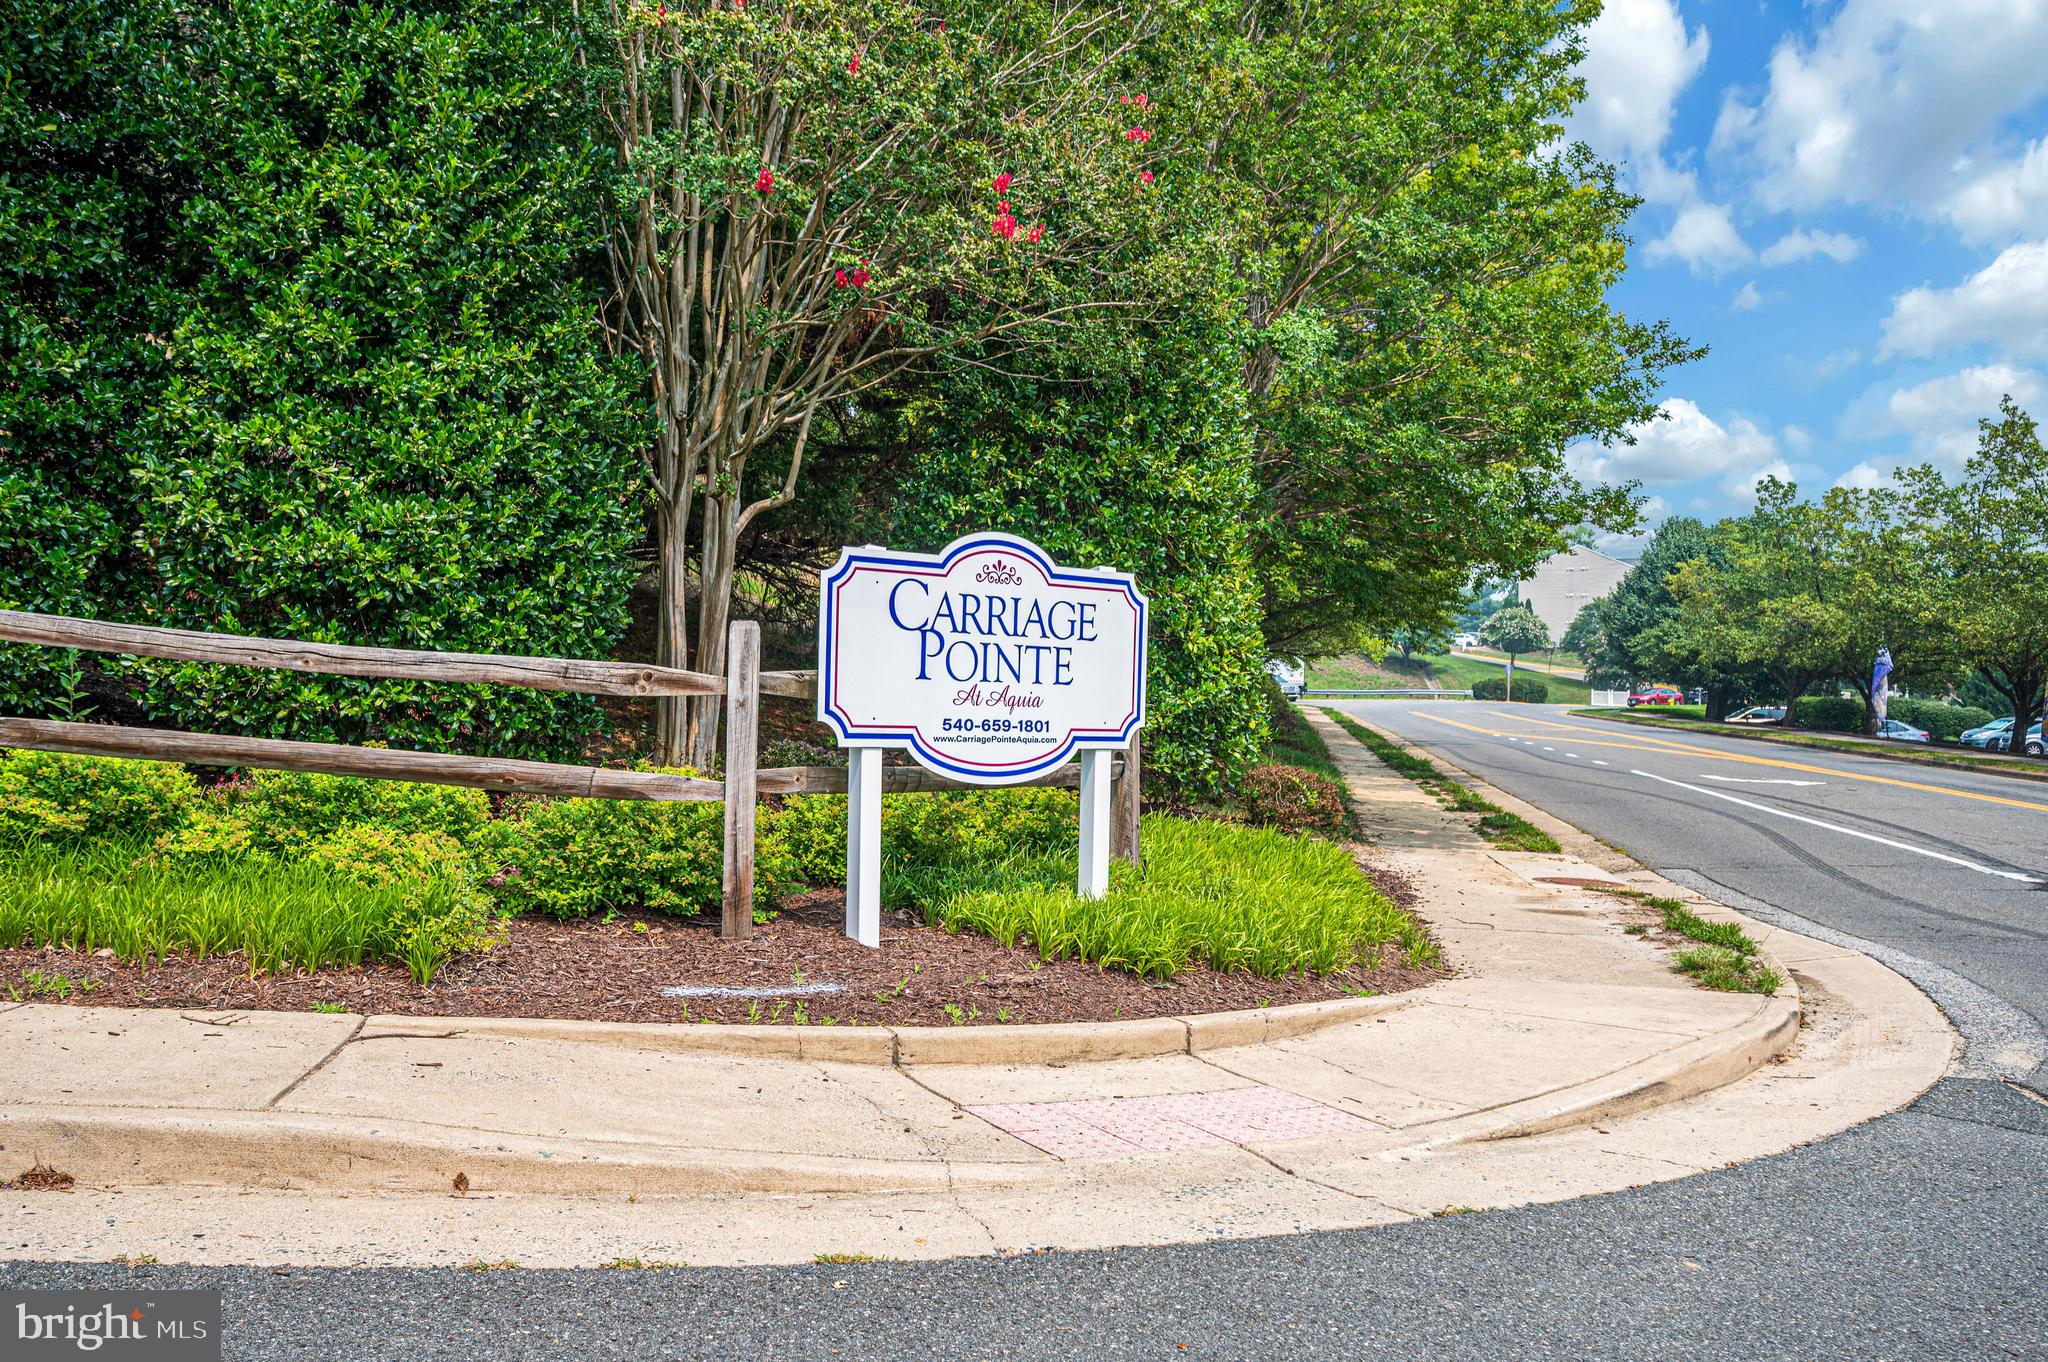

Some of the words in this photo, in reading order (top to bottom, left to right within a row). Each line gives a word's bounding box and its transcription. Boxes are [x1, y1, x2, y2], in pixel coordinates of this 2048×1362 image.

[889, 578, 1098, 642] CARRIAGE
[915, 629, 1074, 686] POINTE
[952, 684, 984, 709] At
[985, 685, 1044, 715] Aquia
[933, 735, 1057, 745] www.CarriagePointeAquia.com
[942, 718, 1050, 733] 540-659-1801
